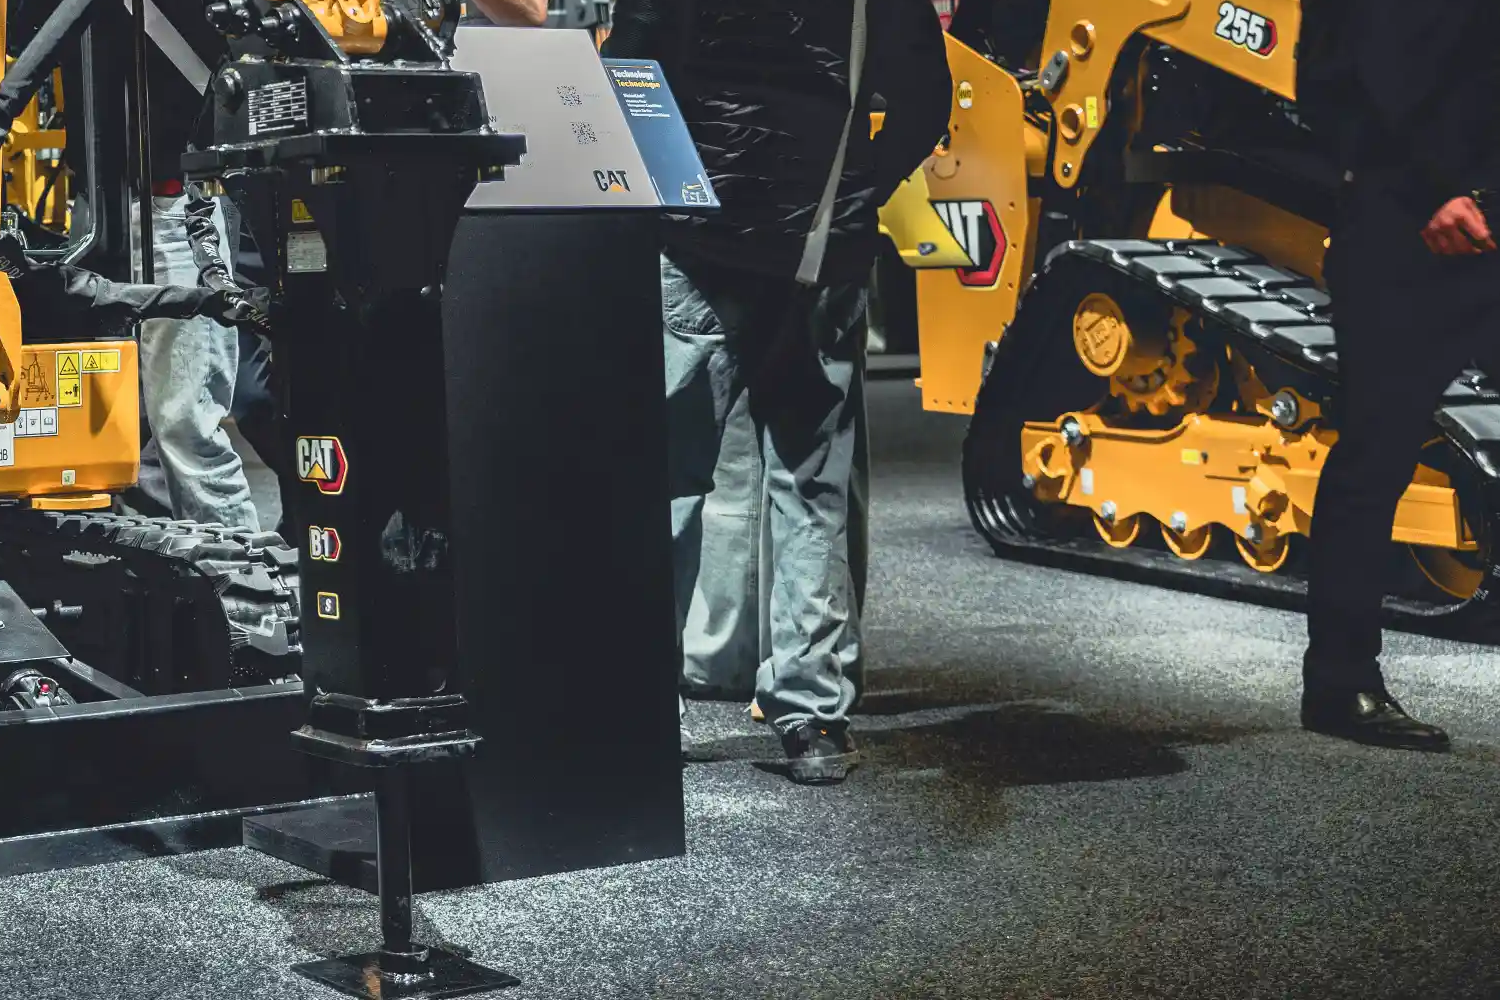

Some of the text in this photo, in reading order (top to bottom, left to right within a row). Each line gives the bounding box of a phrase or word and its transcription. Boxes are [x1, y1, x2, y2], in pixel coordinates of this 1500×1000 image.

[1216, 2, 1266, 51] 255
[611, 70, 654, 81] Technology
[616, 80, 661, 90] Technologie
[593, 169, 631, 192] CAT
[298, 438, 334, 480] CAT
[311, 530, 330, 557] B1
